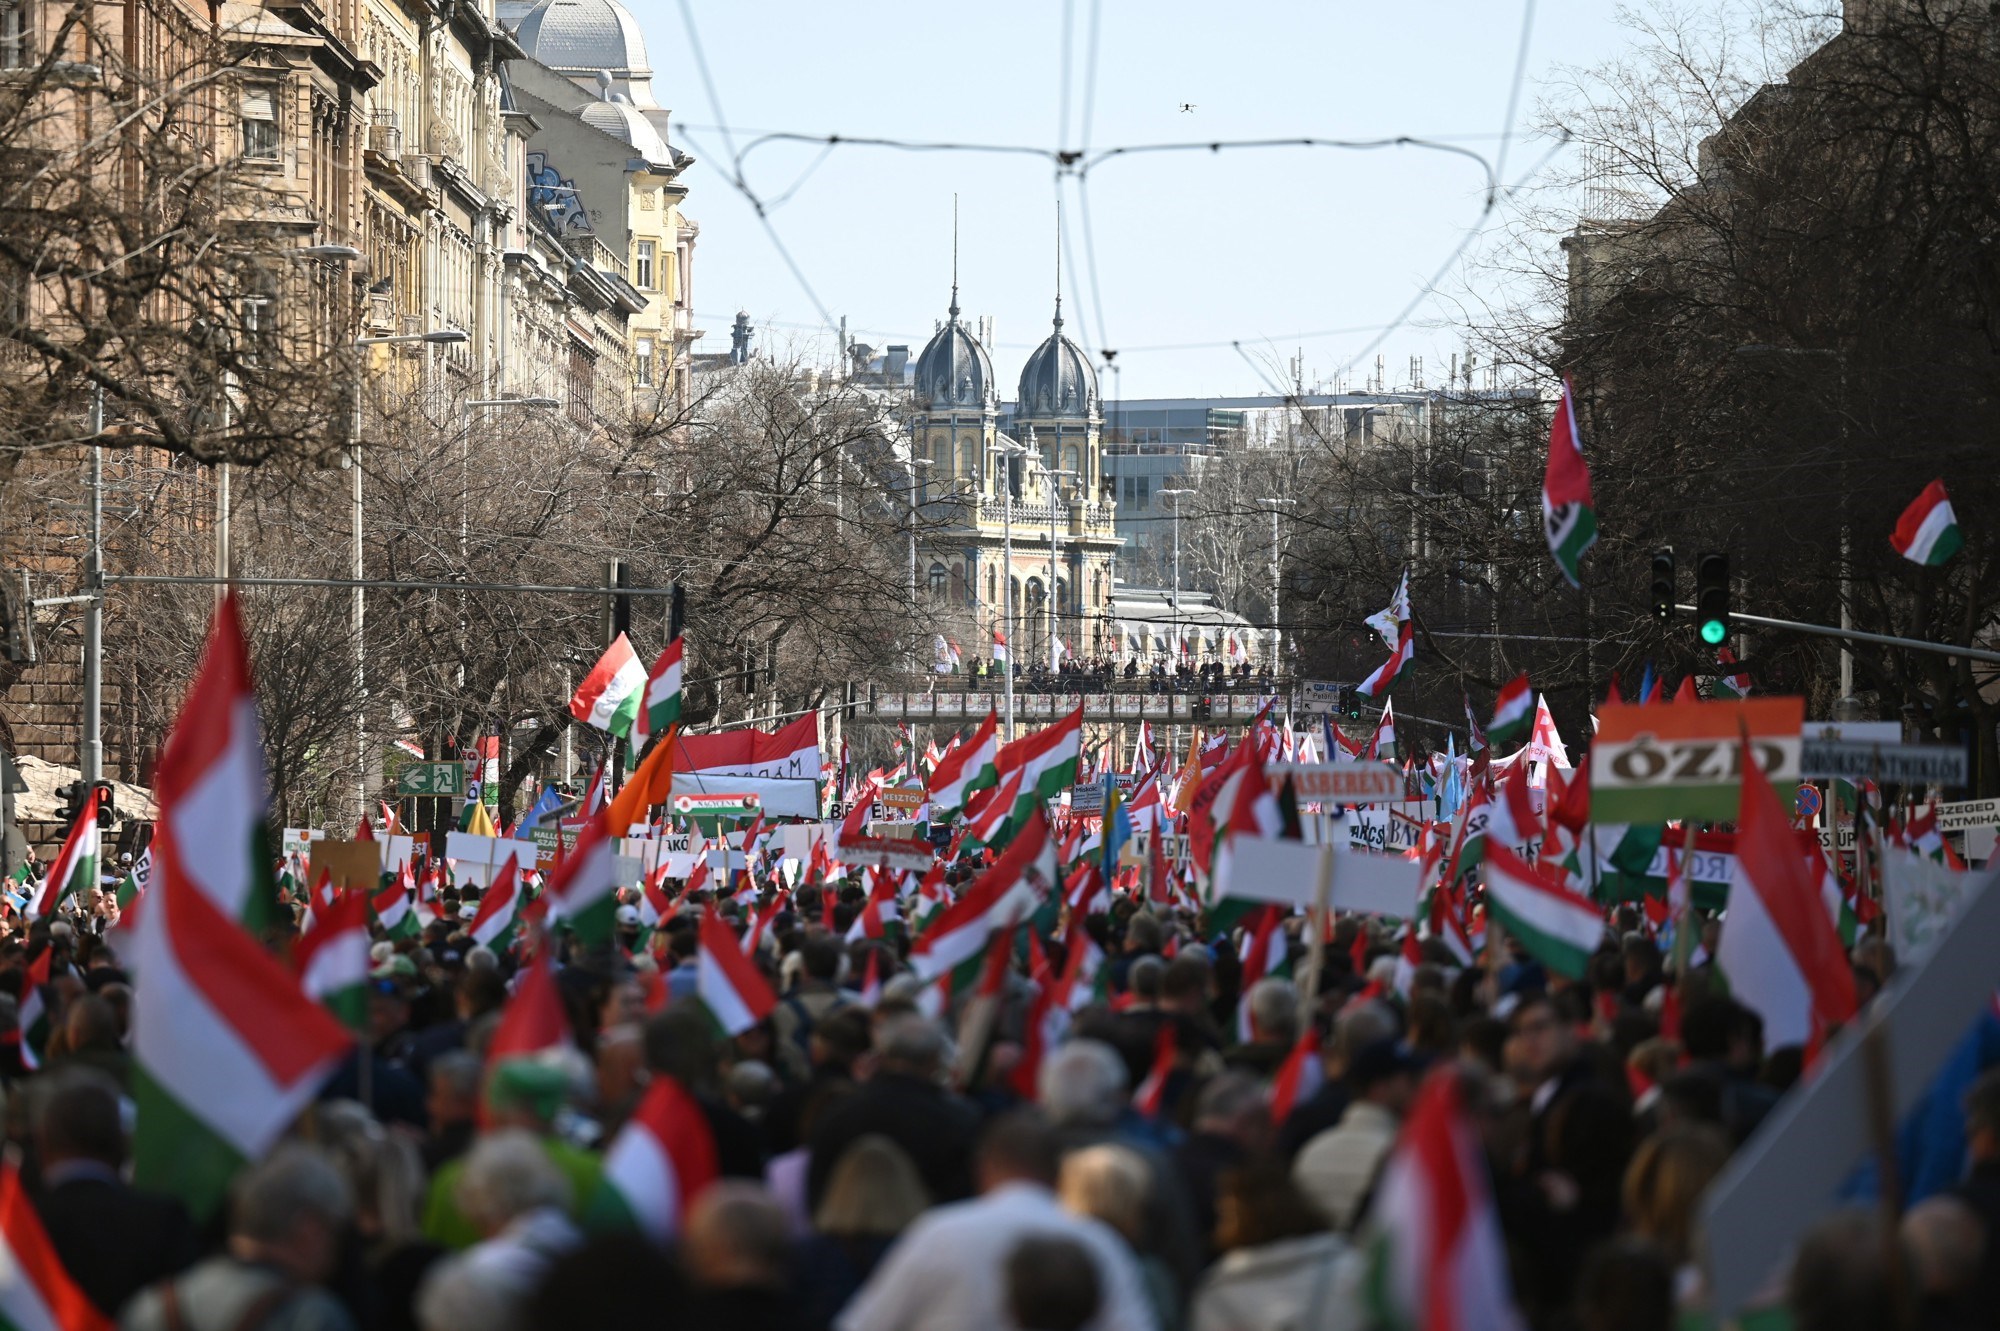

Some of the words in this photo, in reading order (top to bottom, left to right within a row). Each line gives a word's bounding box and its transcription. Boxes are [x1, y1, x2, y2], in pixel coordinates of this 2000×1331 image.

[1612, 733, 1786, 781] ÓZD
[1935, 801, 1996, 817] SZEGED
[1942, 811, 2000, 829] NTMIHÁ
